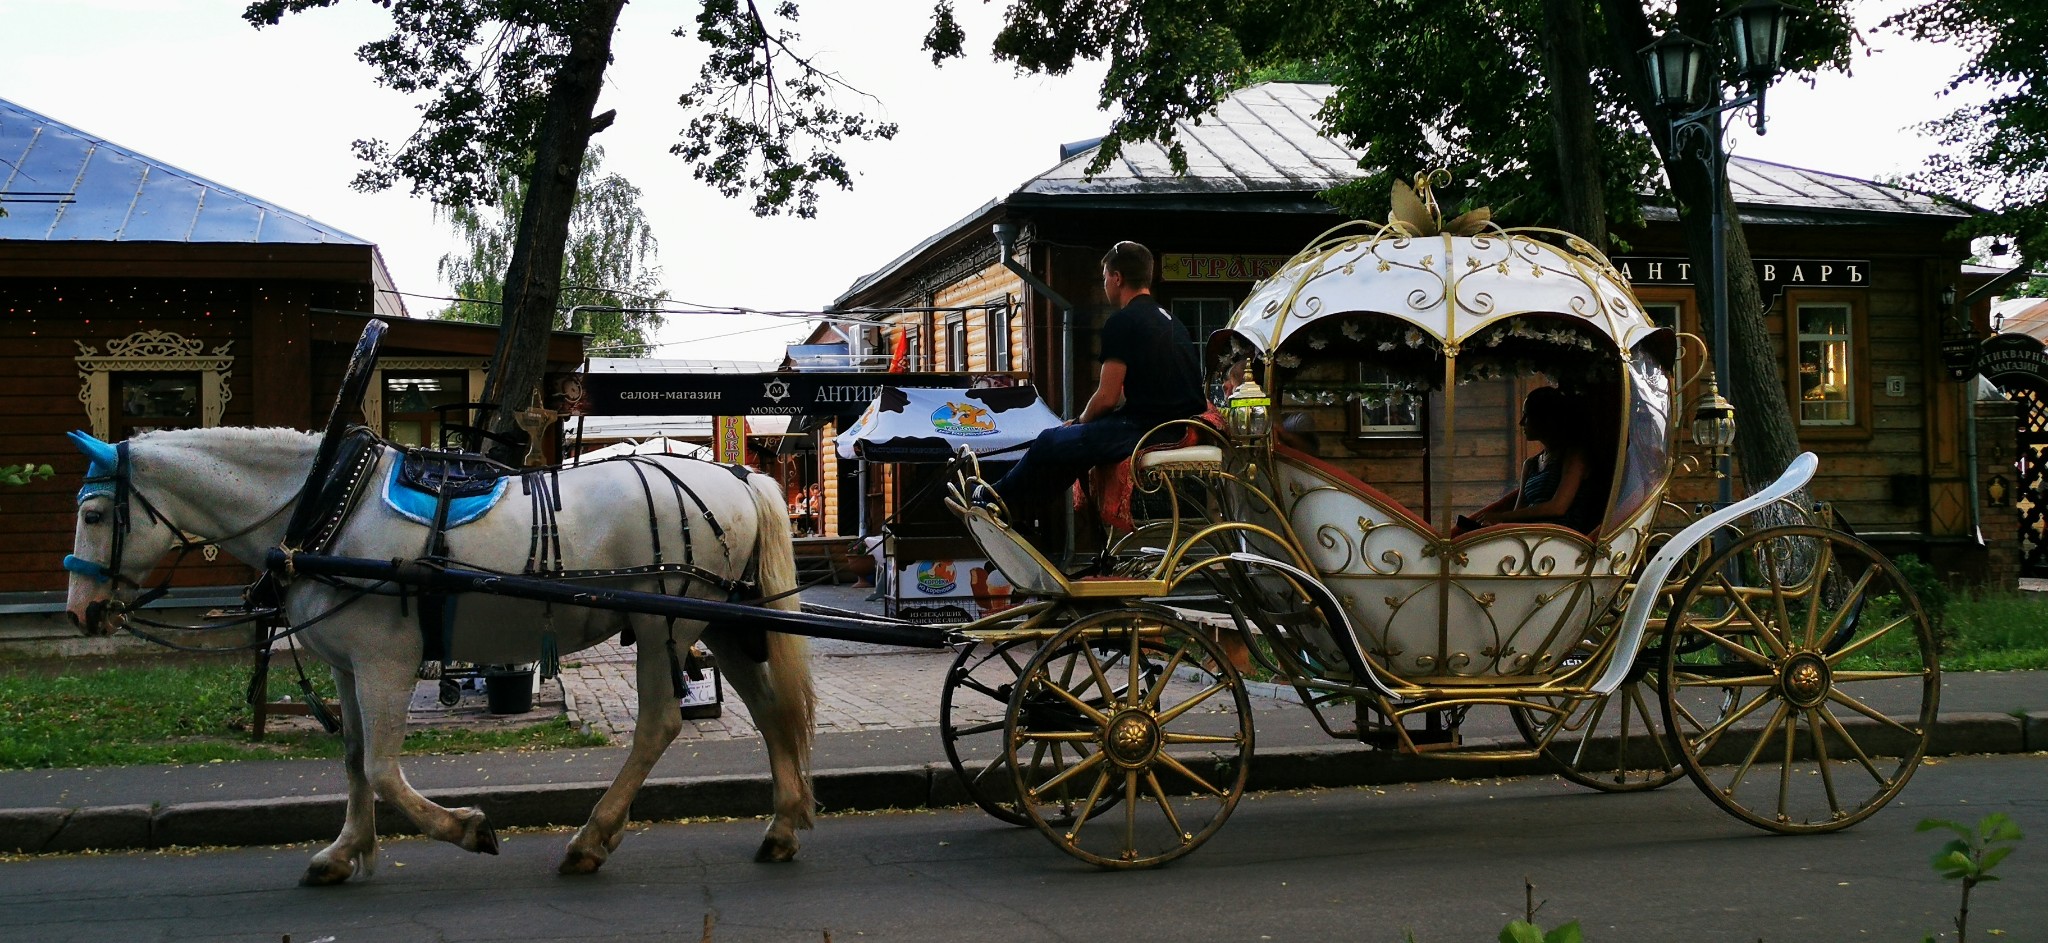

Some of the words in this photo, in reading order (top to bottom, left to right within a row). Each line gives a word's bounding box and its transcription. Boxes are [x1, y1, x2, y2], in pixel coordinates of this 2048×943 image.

[1621, 263, 1862, 282] АНТВАРЪ
[1991, 361, 2039, 373] МАГАЗИН
[620, 391, 721, 400] салон-магазин
[750, 406, 804, 415] MOROZOV
